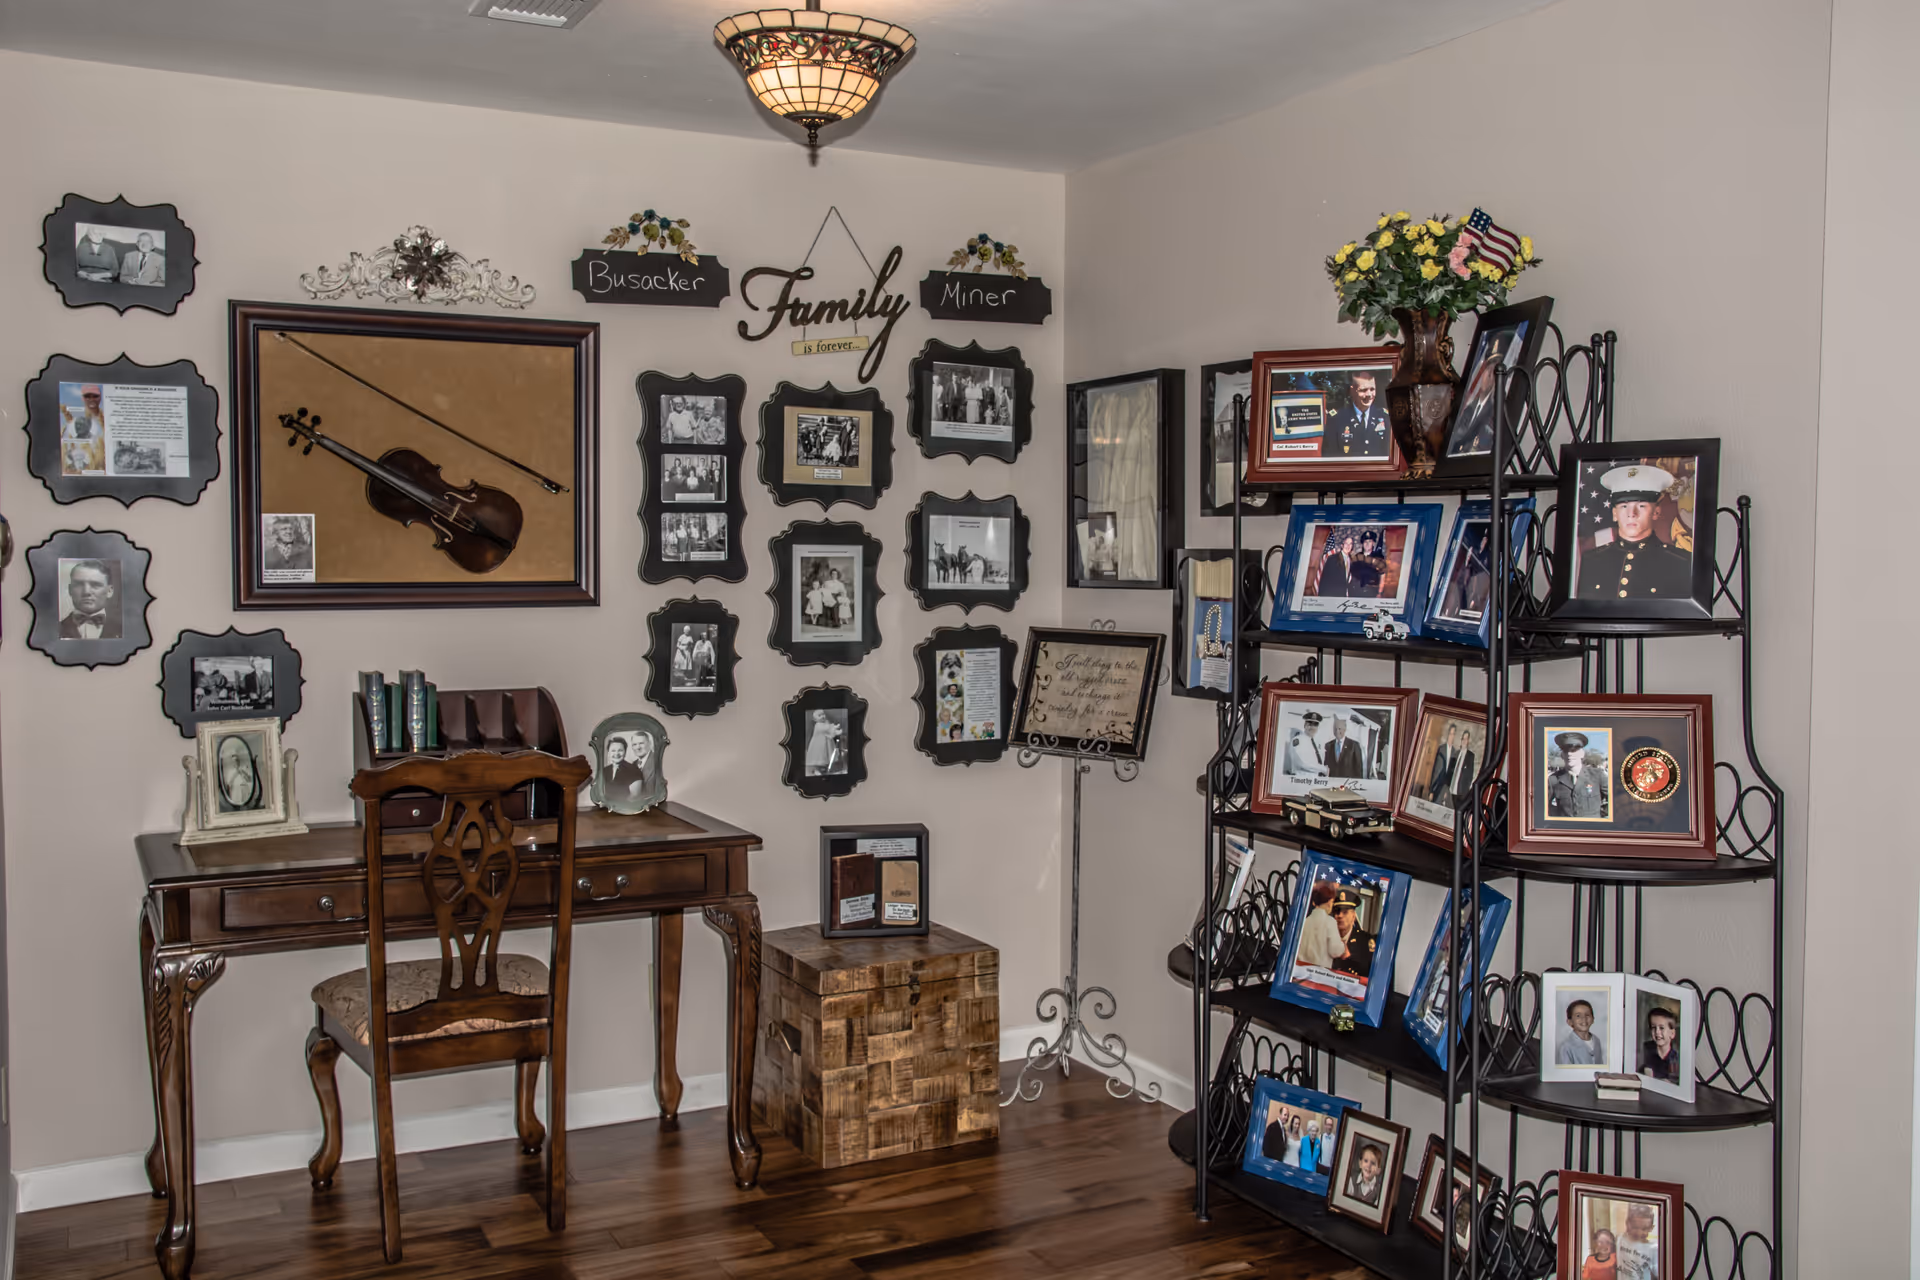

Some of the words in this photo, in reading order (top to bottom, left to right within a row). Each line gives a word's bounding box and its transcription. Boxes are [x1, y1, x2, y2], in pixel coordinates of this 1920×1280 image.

[589, 260, 706, 294] Busacker
[940, 281, 1017, 310] Miner
[737, 245, 911, 385] Family
[803, 343, 813, 354] is
[1290, 777, 1313, 786] Timothy
[1313, 778, 1329, 786] Berry
